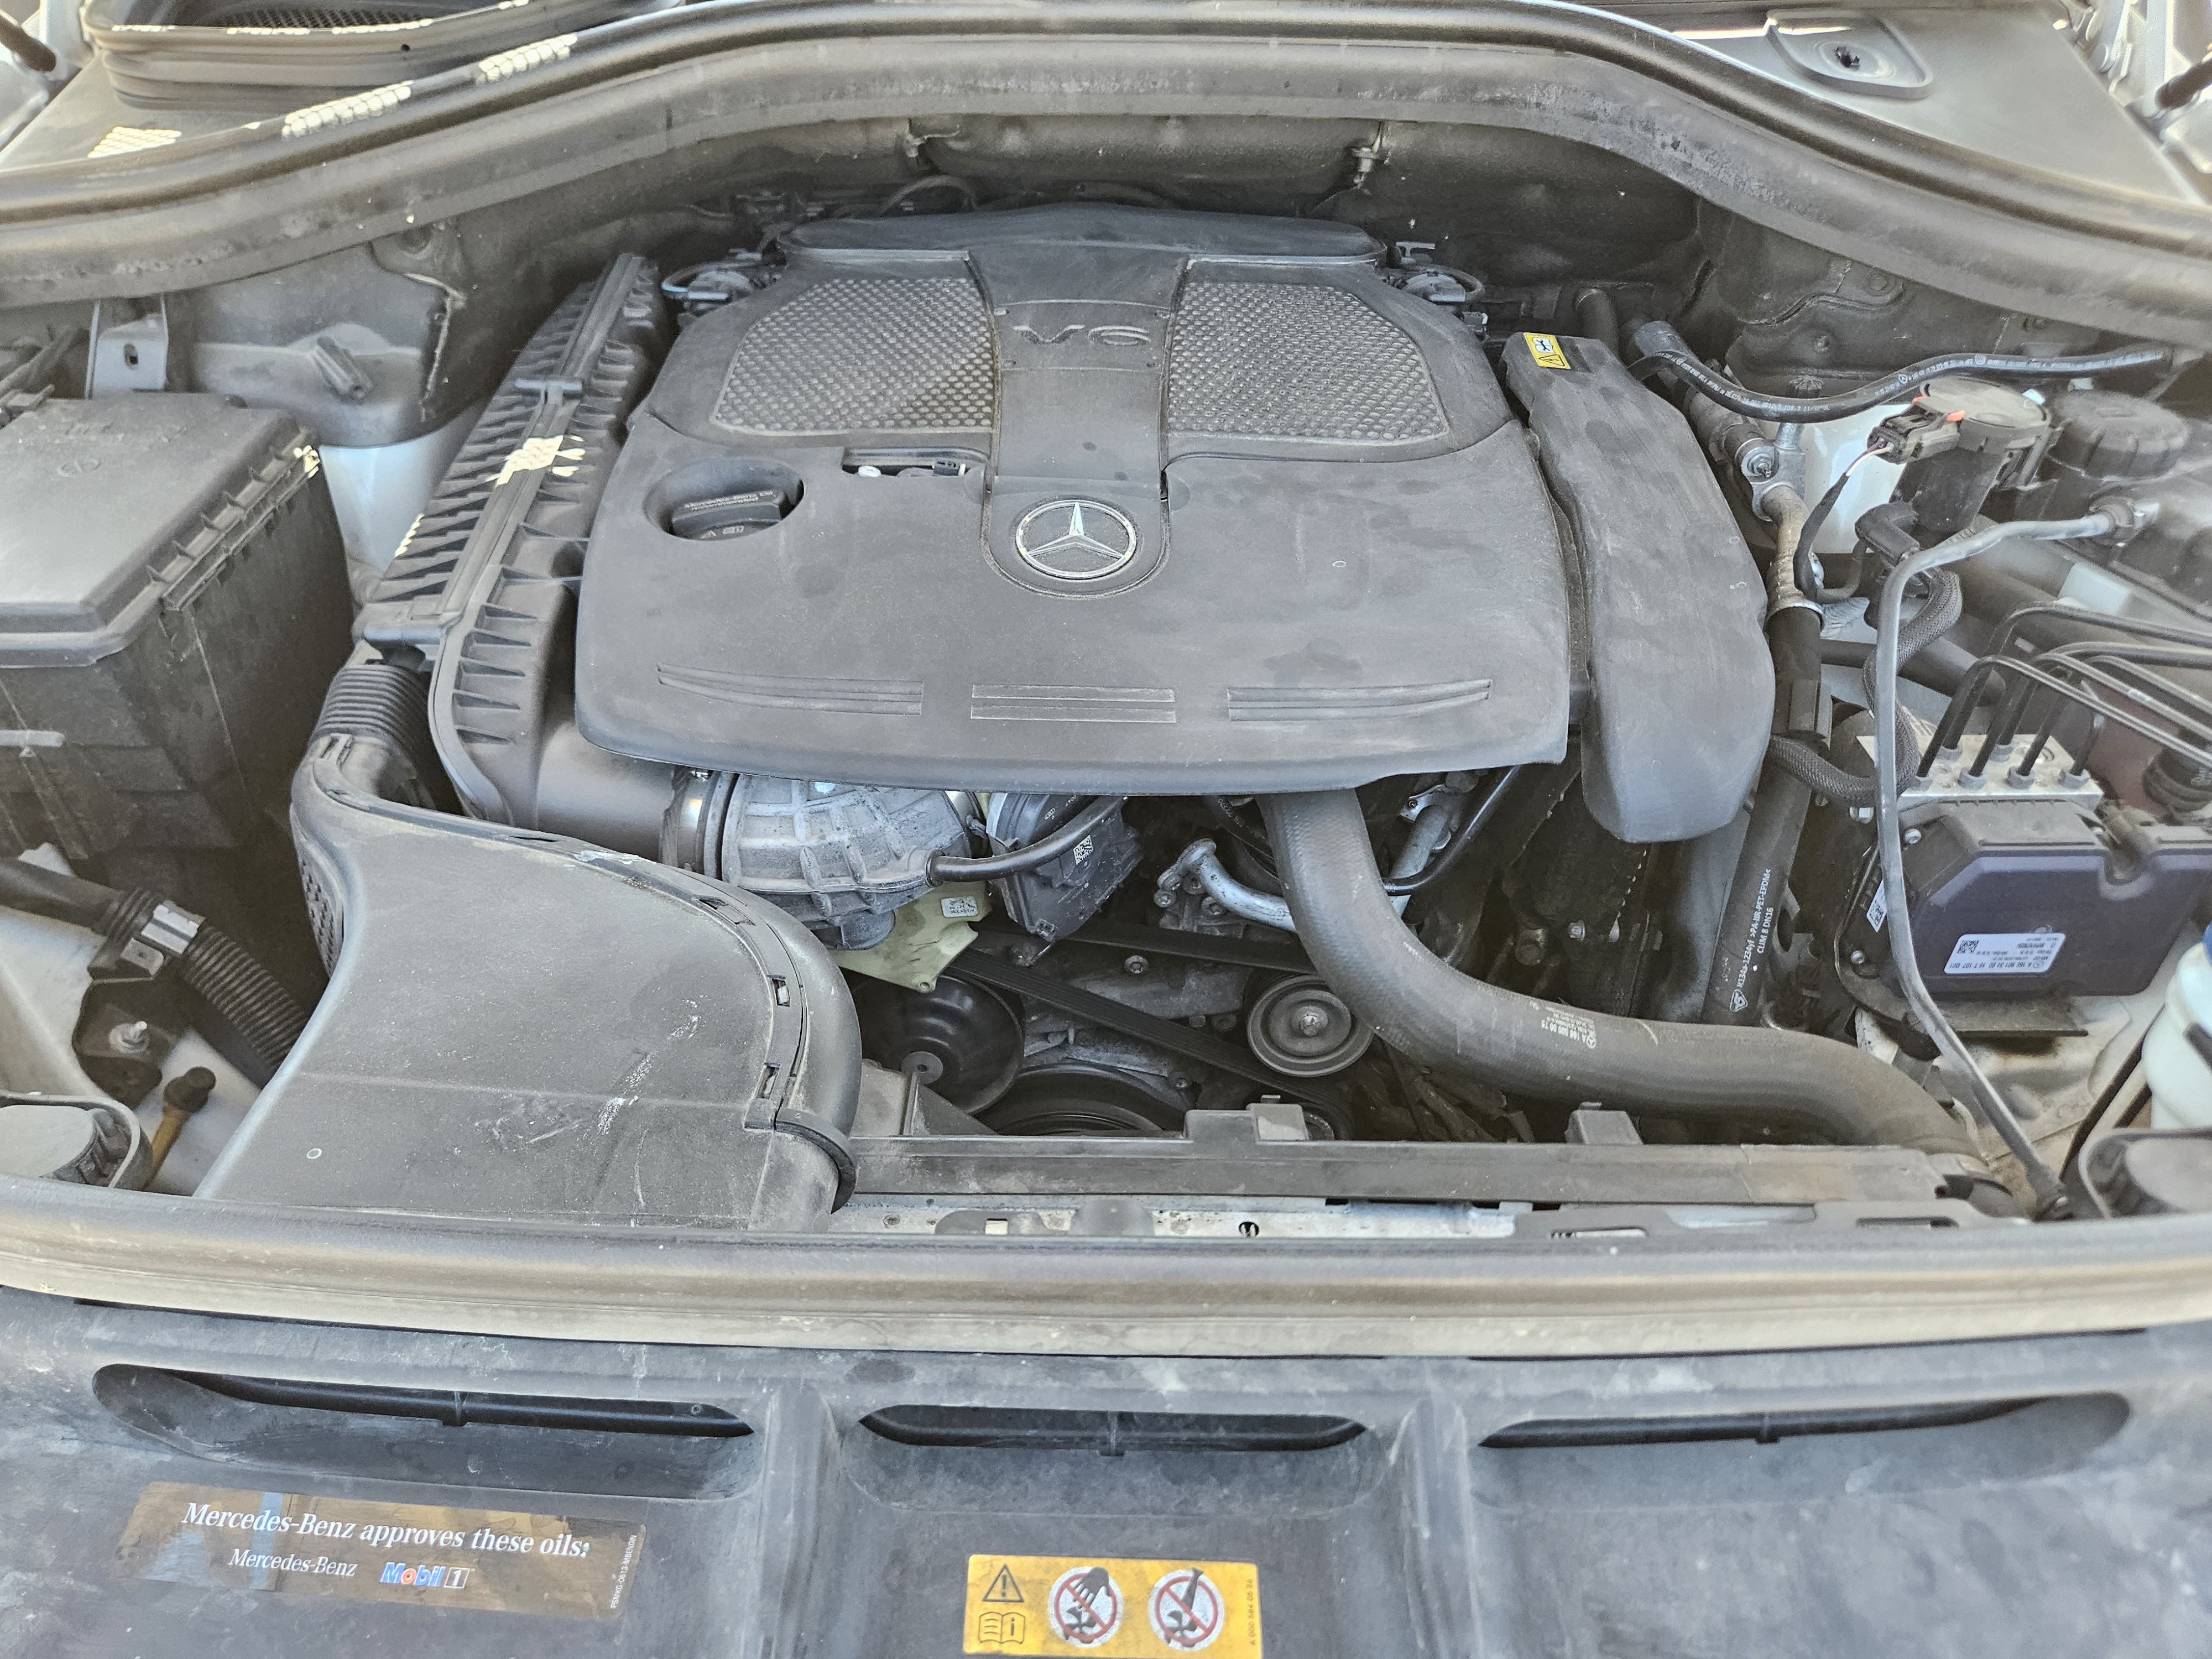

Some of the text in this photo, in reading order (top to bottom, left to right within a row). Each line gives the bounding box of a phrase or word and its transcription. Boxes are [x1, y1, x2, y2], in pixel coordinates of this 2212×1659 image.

[1013, 324, 1152, 346] V6
[1757, 934, 1767, 953] CLIM
[1763, 907, 1774, 928] DN16
[182, 1503, 590, 1558] Mercedes-Benz approves these oils:
[227, 1548, 358, 1577] Mercedes-Benz
[380, 1561, 445, 1587] Mobil
[610, 1535, 637, 1609] PSMKG-0613-MBENGIN
